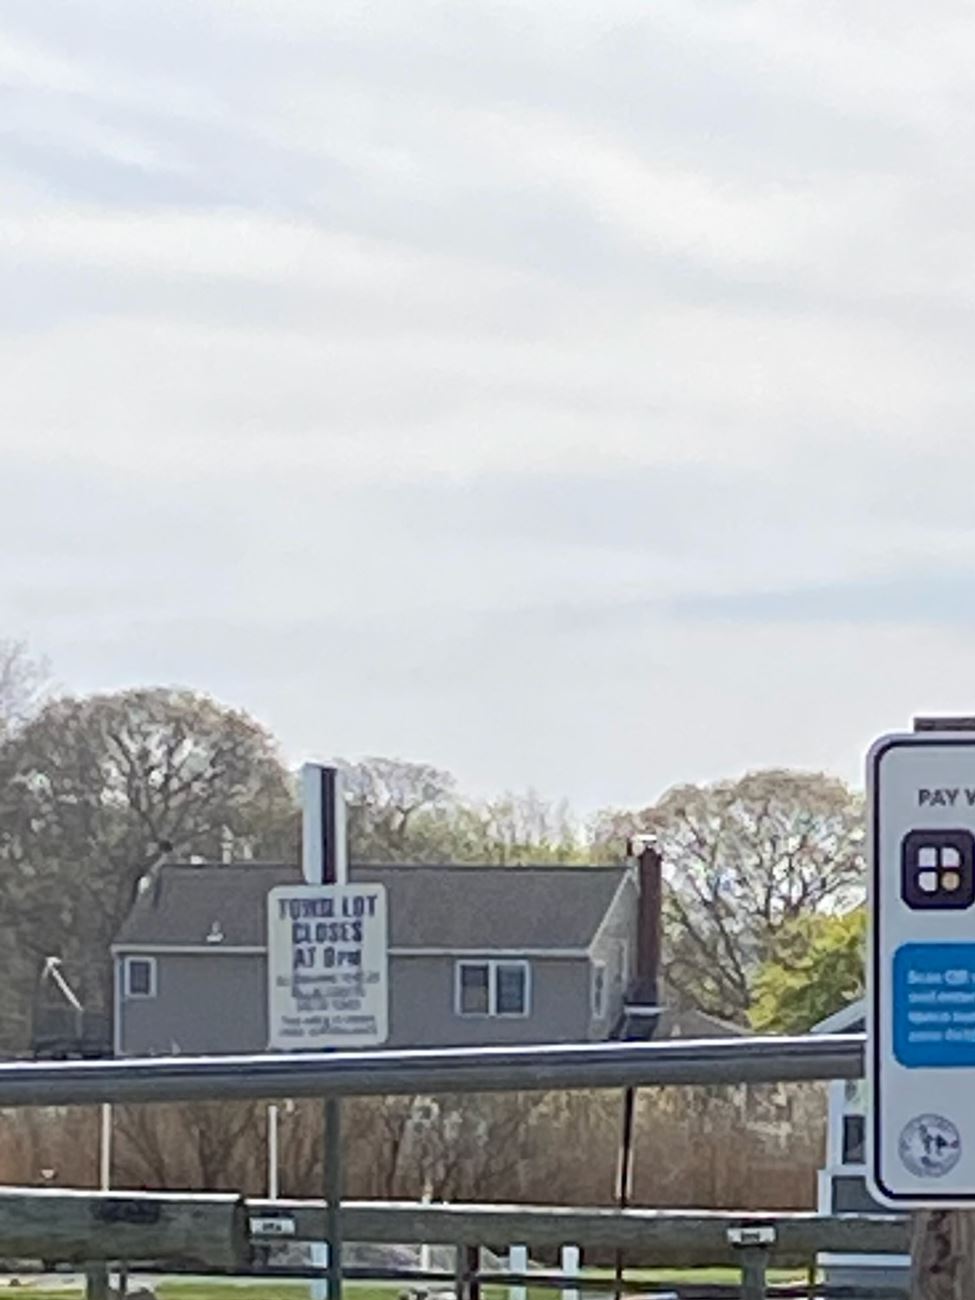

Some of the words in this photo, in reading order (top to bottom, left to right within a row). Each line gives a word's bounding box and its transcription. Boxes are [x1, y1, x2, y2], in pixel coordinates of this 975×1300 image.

[918, 788, 960, 807] PAY
[342, 895, 378, 918] LOT
[291, 920, 363, 944] CLOSES
[294, 946, 317, 969] AT
